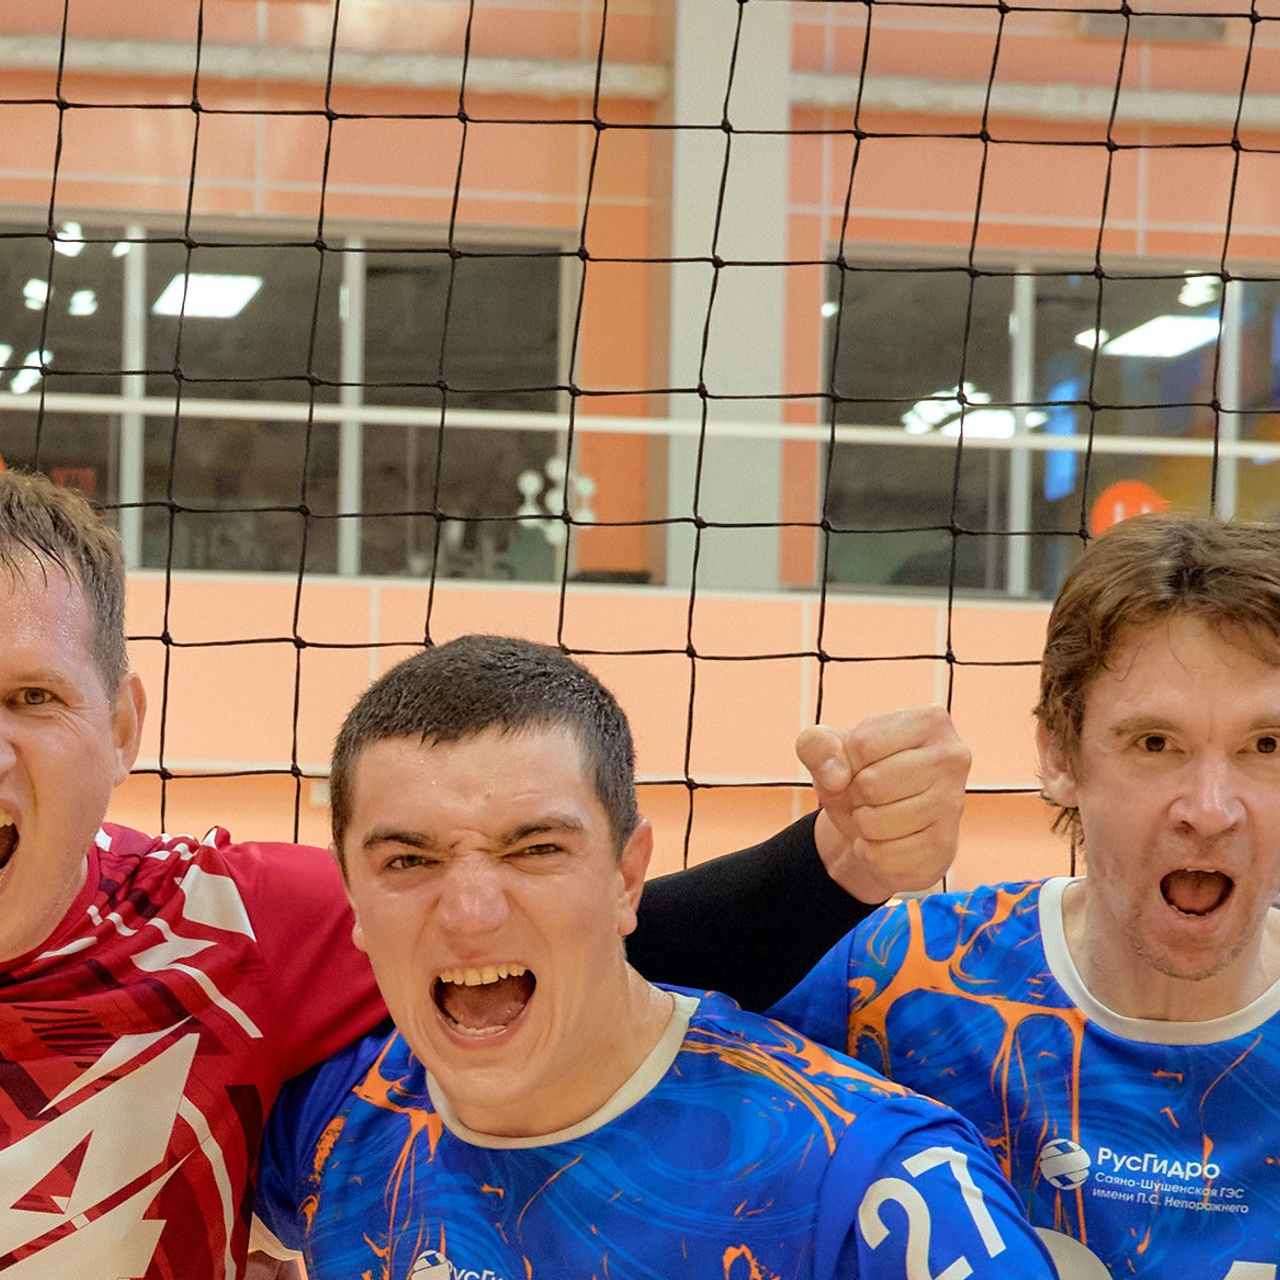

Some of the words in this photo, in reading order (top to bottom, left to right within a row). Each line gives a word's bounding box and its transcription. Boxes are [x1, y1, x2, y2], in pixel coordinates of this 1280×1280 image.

[1096, 1147, 1221, 1180] РусГидро
[1094, 1171, 1218, 1197] Саяно-Шушенская
[1220, 1187, 1245, 1199] ГЭС
[1092, 1188, 1134, 1202] имени
[1136, 1194, 1161, 1206] П.С.
[1165, 1196, 1250, 1214] Непорожнего
